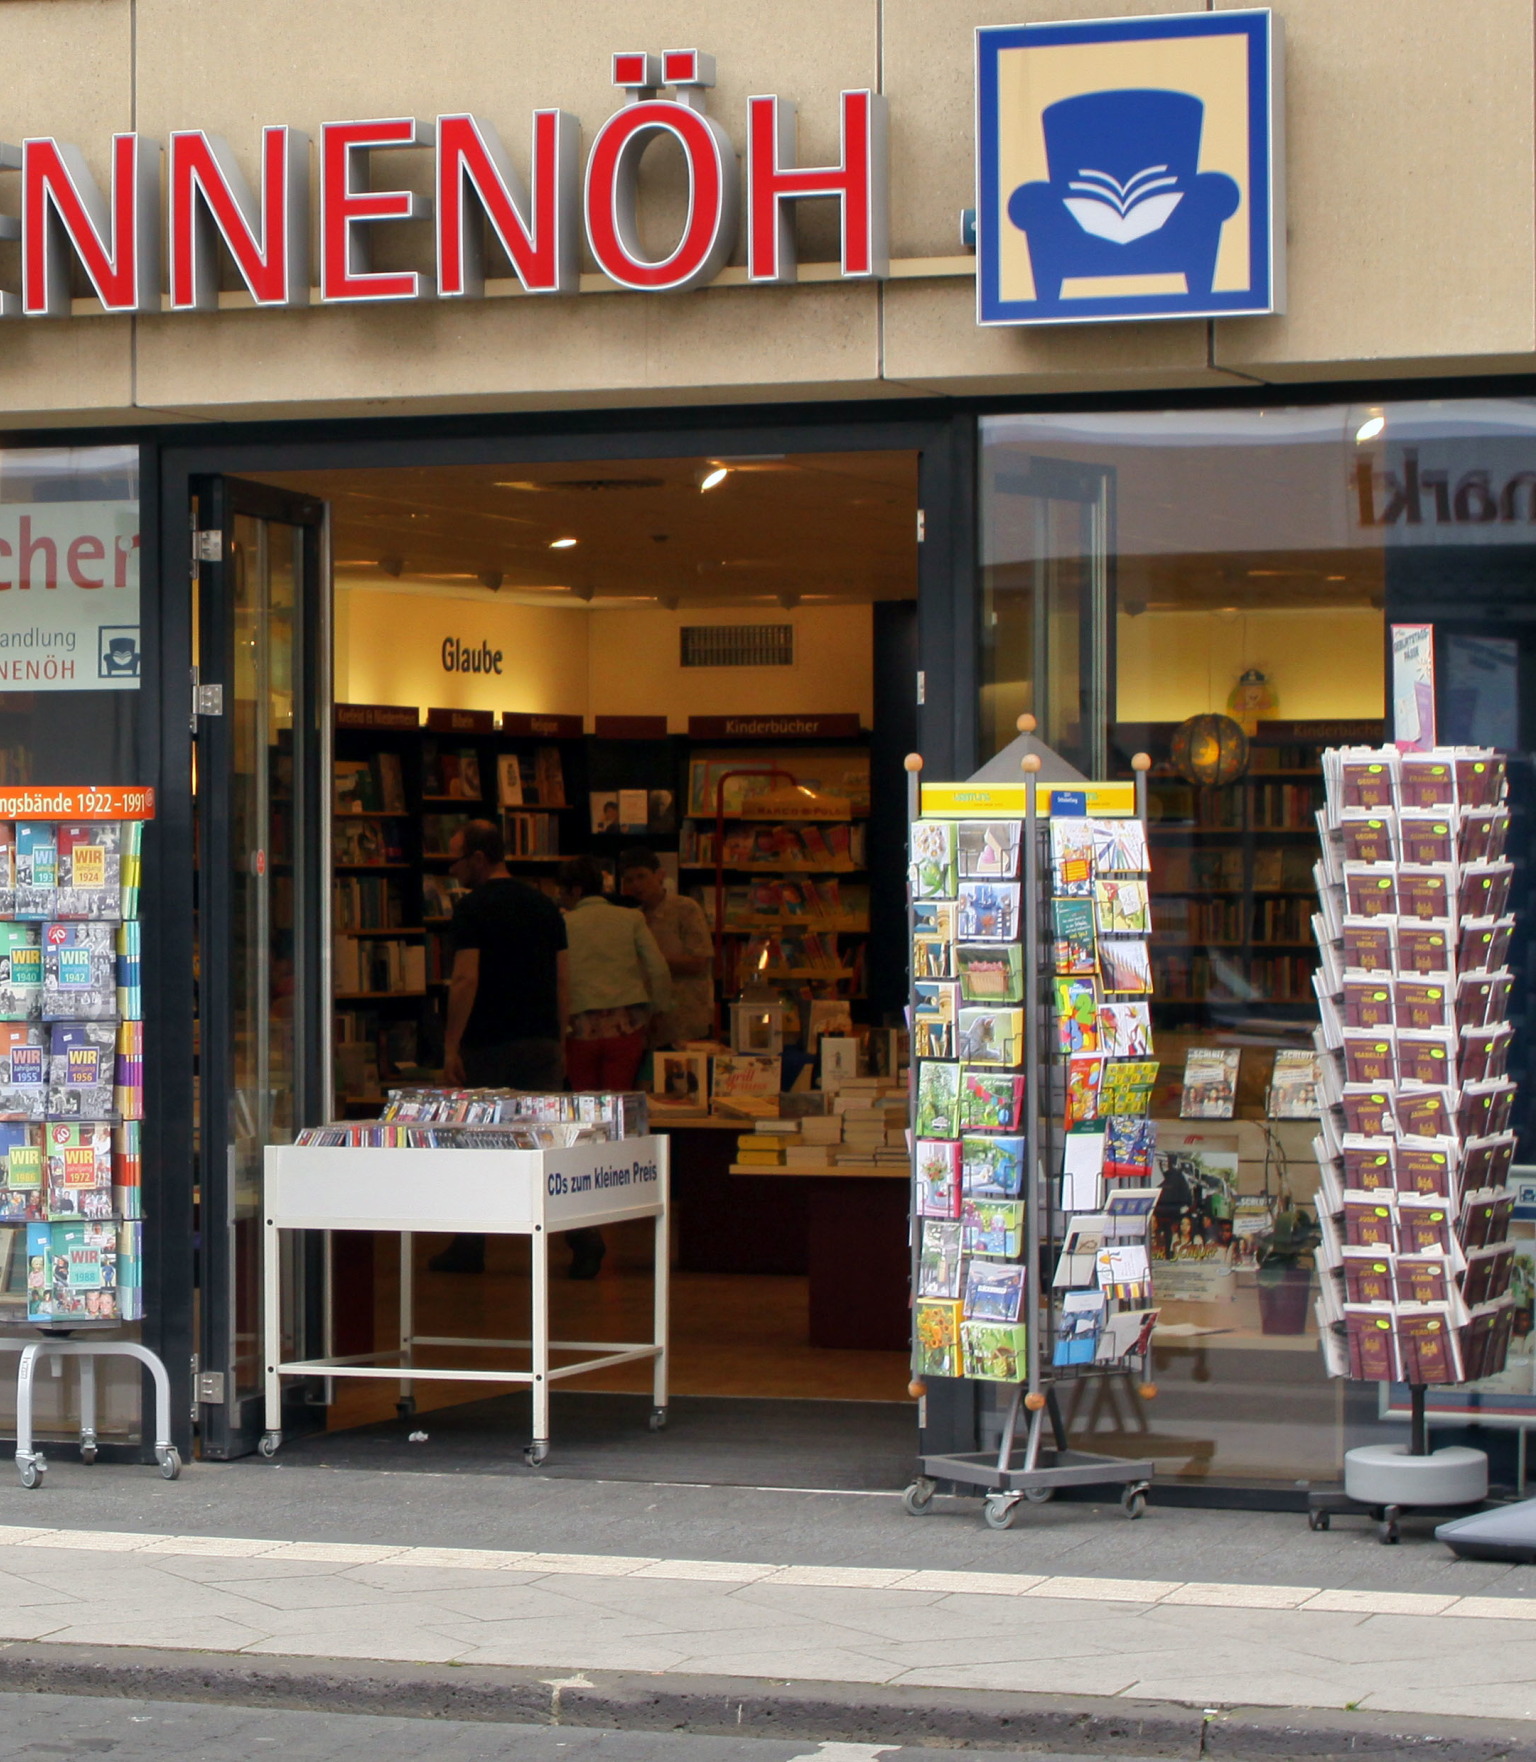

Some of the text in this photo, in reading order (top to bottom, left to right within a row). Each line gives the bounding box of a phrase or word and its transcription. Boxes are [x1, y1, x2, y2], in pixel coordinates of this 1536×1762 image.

[441, 636, 504, 676] Glaube
[725, 718, 820, 734] Kinderbücher
[77, 793, 112, 813] 1922
[35, 850, 55, 864] WI
[74, 850, 103, 864] WIR
[38, 872, 54, 882] 193
[79, 872, 99, 882] 1924
[51, 928, 66, 944] 70
[12, 950, 41, 964] WIR
[60, 950, 89, 964] WIR
[16, 973, 36, 982] 1940
[64, 973, 86, 982] 1942
[12, 1050, 41, 1064] WIR
[69, 1050, 97, 1064] WIR
[17, 1073, 38, 1082] 1955
[72, 1073, 93, 1082] 1956
[56, 1128, 71, 1144] 40
[11, 1150, 39, 1164] WIR
[65, 1150, 93, 1164] WIR
[70, 1173, 91, 1182] 1972
[547, 1160, 657, 1196] CDs zum kleinen Preis
[71, 1250, 99, 1264] WIR
[75, 1273, 96, 1282] 1988
